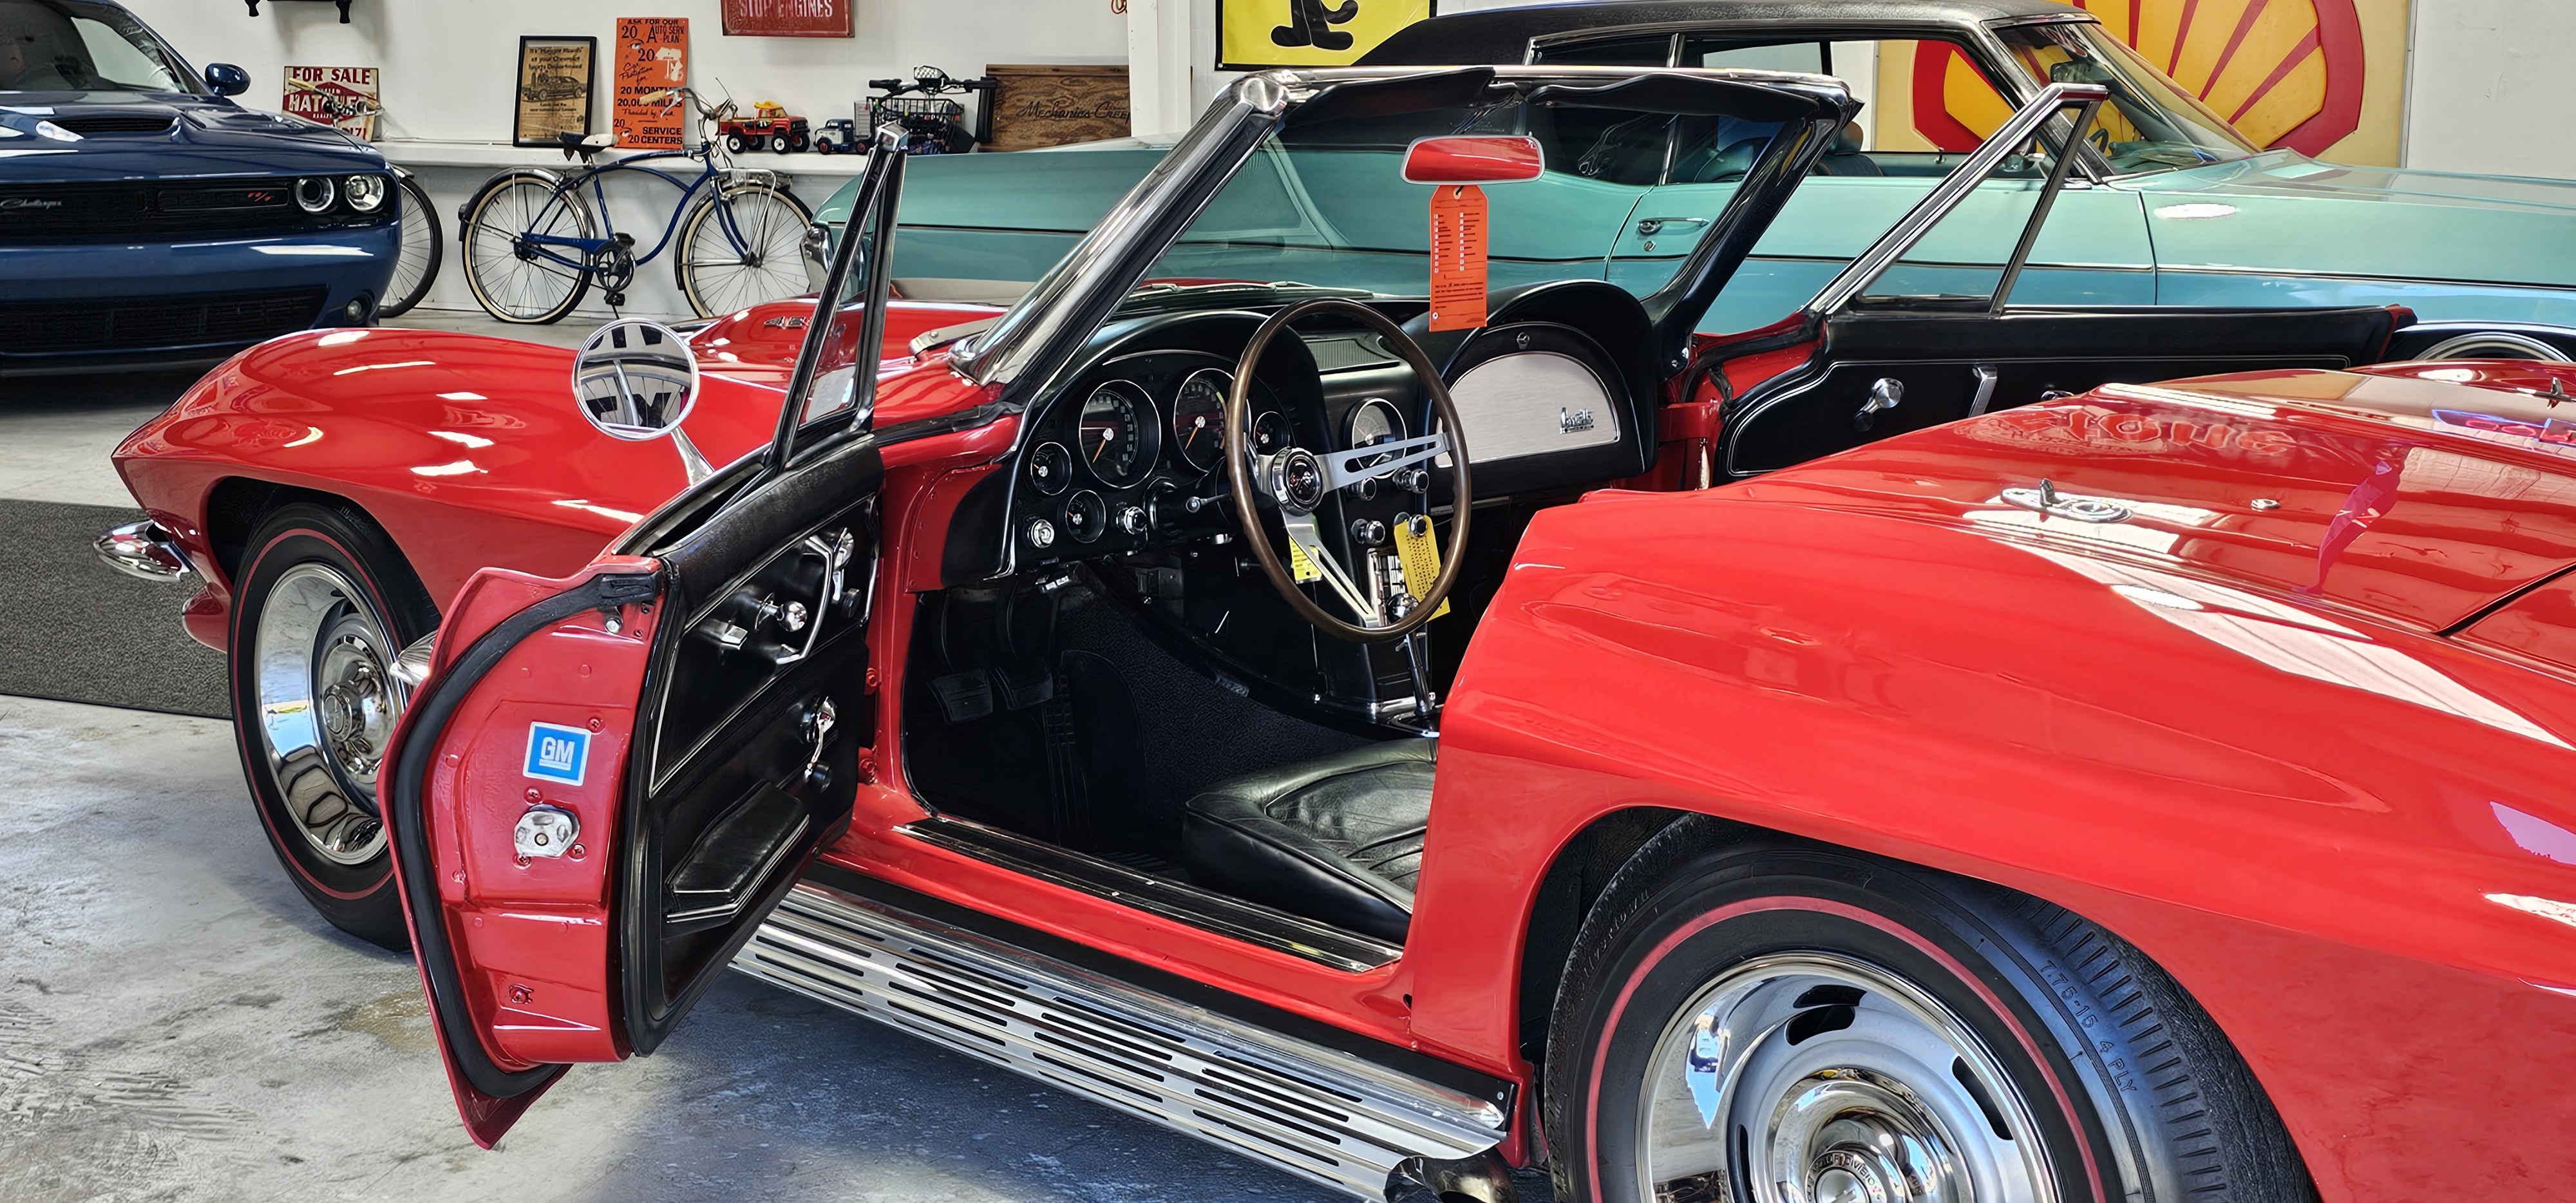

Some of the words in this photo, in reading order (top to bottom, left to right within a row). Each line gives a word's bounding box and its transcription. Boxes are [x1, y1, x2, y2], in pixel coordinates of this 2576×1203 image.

[621, 25, 638, 39] 20
[646, 25, 667, 43] AUTO
[638, 48, 656, 62] 20
[292, 67, 323, 82] FOR
[331, 68, 370, 85] SALE
[634, 86, 672, 95] MONT
[1095, 100, 1131, 124] Cree
[614, 118, 625, 128] 20
[642, 126, 682, 135] SERVICE
[628, 135, 639, 144] 20
[640, 135, 683, 145] CENTERS
[540, 736, 576, 764] GM
[2040, 959, 2099, 1028] 7.75-15
[2099, 1040, 2114, 1054] 4
[2107, 1057, 2137, 1092] PLY
